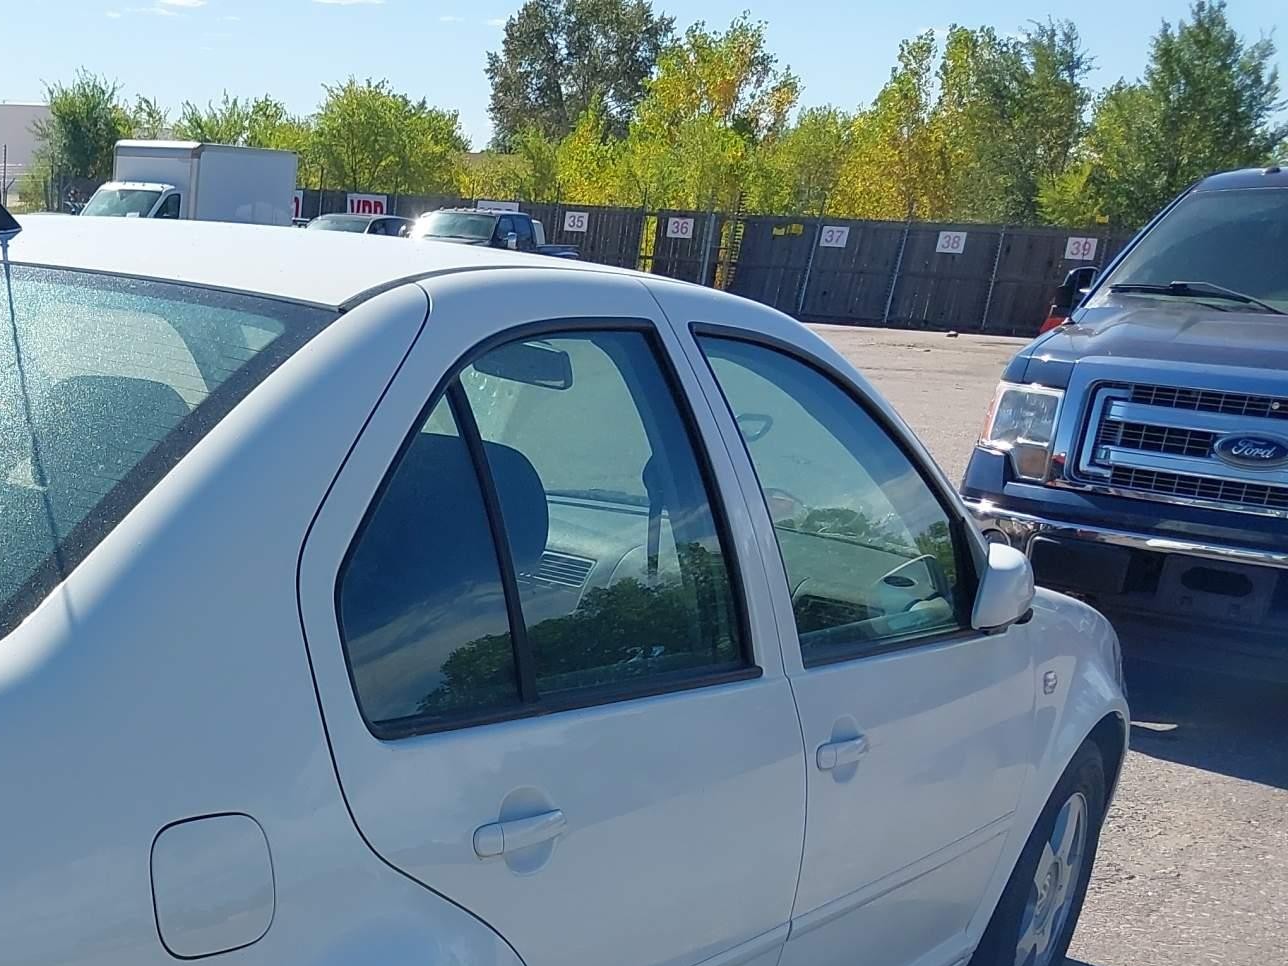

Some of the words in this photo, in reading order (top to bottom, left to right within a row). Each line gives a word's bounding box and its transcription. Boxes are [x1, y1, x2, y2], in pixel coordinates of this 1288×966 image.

[568, 215, 585, 229] 35
[672, 220, 689, 235] 36
[825, 230, 844, 244] 37
[942, 234, 961, 249] 38
[1070, 241, 1092, 256] 39
[1232, 439, 1277, 458] Ford
